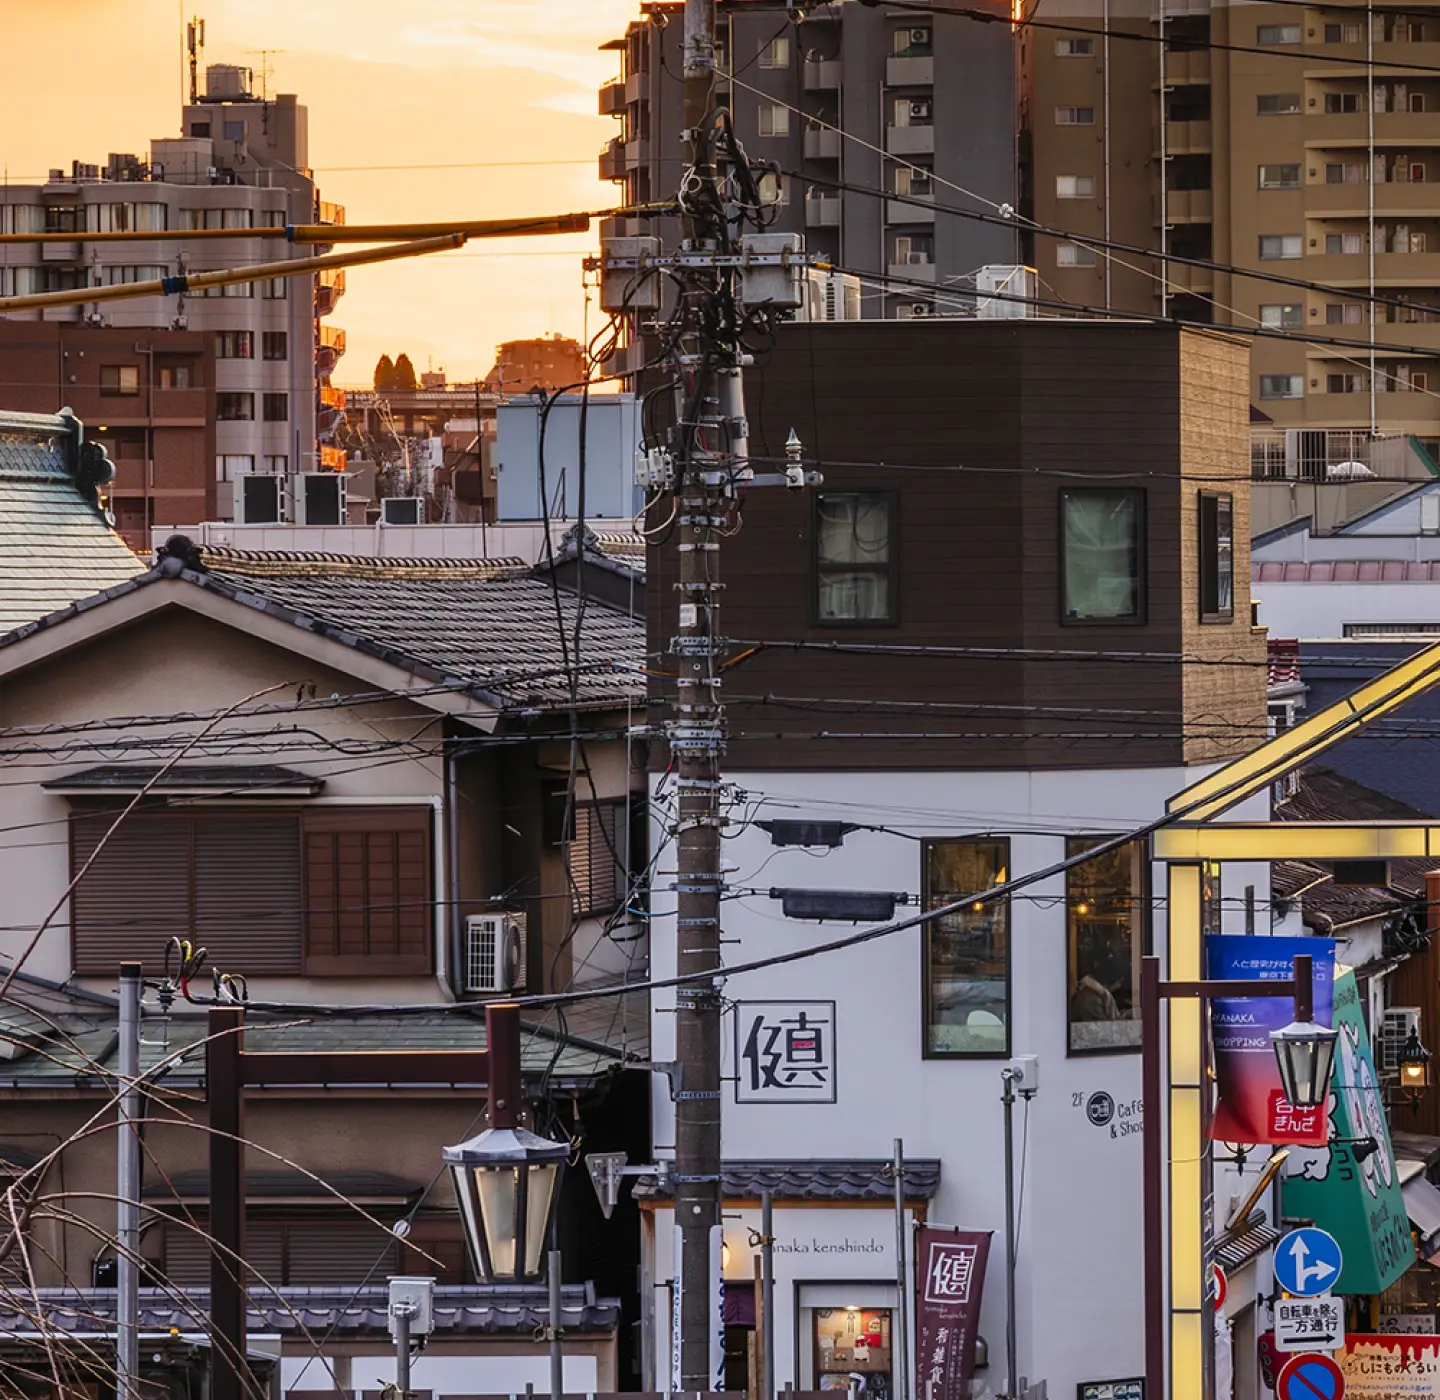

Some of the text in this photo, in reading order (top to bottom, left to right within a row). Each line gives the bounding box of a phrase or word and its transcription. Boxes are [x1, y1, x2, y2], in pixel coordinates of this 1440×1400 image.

[1071, 1091, 1084, 1108] 2F
[1117, 1099, 1144, 1118] Café
[1109, 1123, 1118, 1139] &
[1273, 1115, 1316, 1133] ぎんざ
[771, 1238, 885, 1254] naka kenshindo
[1279, 1303, 1338, 1319] 自転車を除く
[1279, 1319, 1338, 1333] 一方通行
